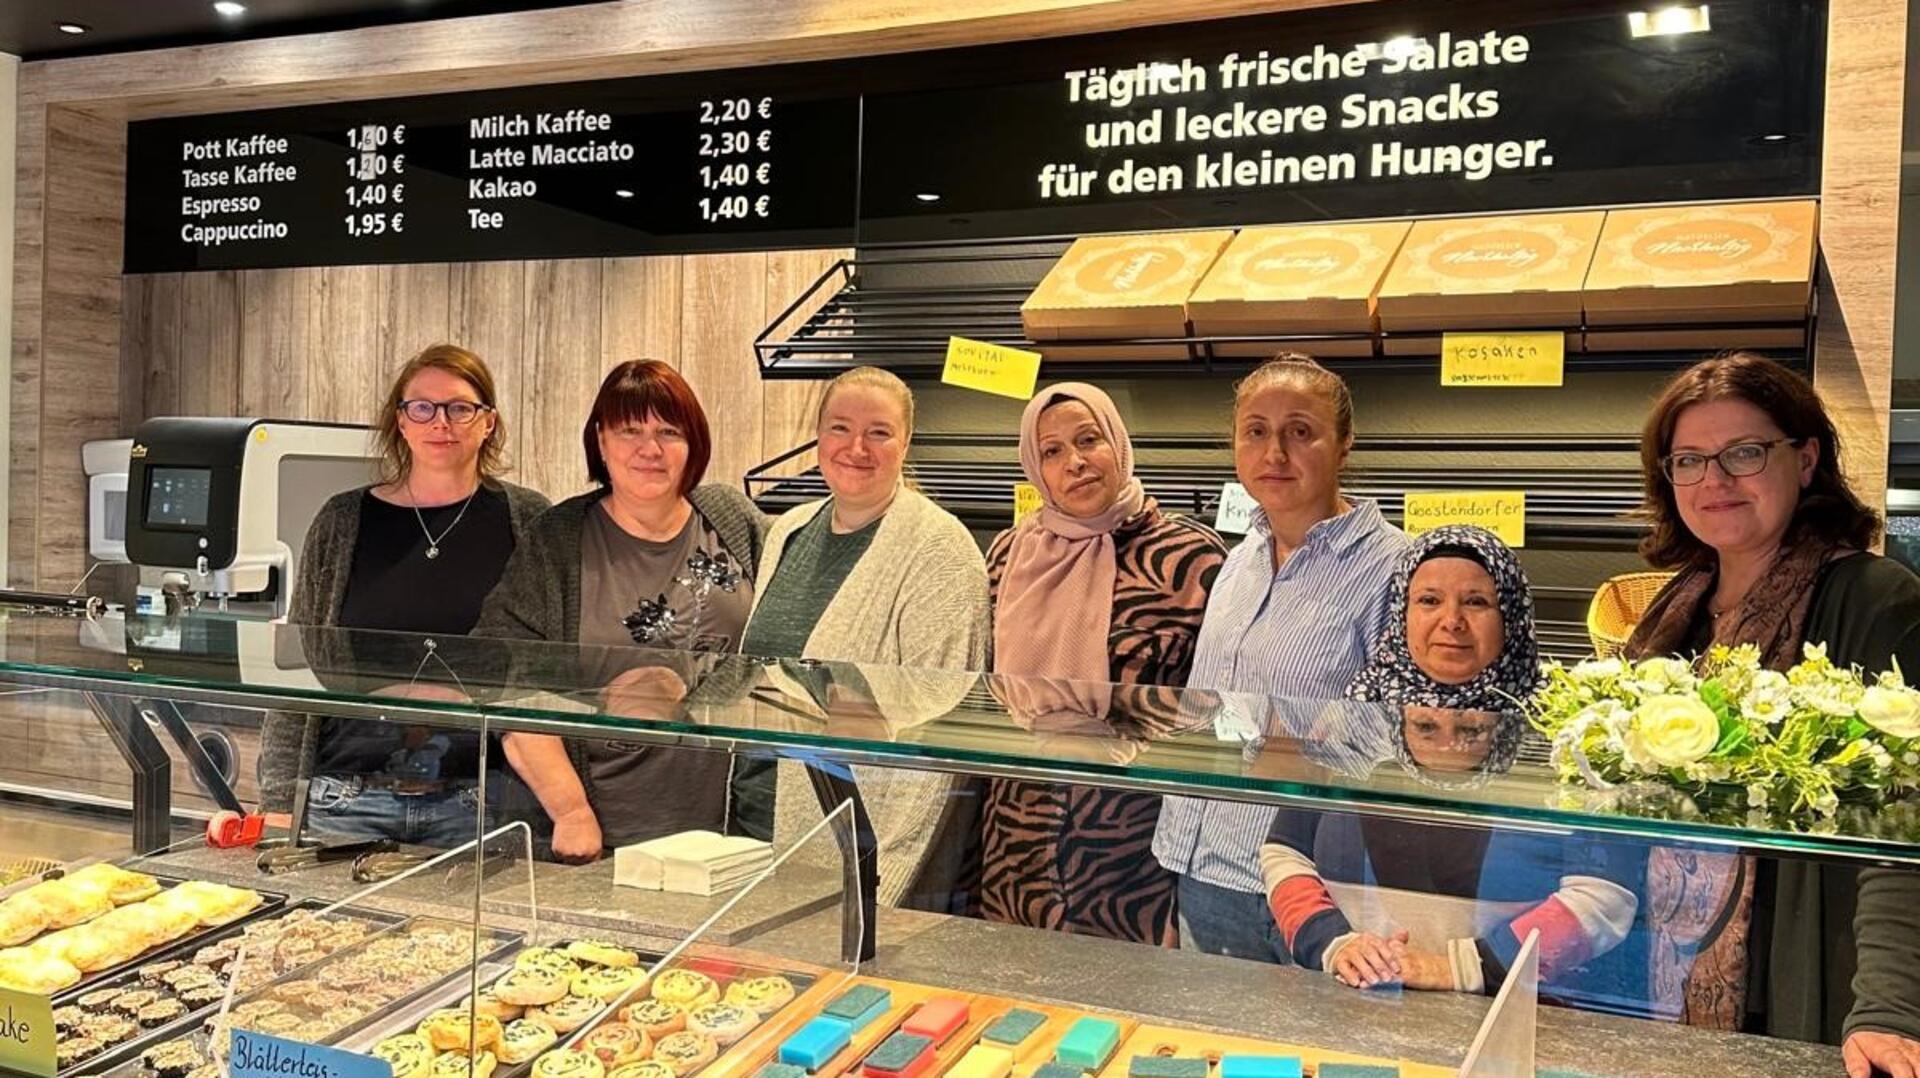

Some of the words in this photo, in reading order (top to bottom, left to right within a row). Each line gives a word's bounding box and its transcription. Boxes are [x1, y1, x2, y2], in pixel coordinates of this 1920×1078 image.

[1065, 57, 1206, 108] Täglich
[1219, 43, 1367, 88] frische
[1381, 31, 1530, 75] Salate
[470, 115, 529, 139] Milch
[536, 110, 612, 134] Kaffee
[700, 99, 751, 125] 2,20
[758, 97, 772, 119] €
[1086, 108, 1162, 148] und
[1176, 102, 1327, 141] leckere
[1341, 83, 1499, 128] Snacks
[183, 141, 222, 161] Pott
[226, 135, 288, 158] Kaffee
[393, 124, 406, 145] €
[469, 148, 526, 169] Latte
[532, 140, 634, 166] Macciato
[699, 131, 750, 157] 2,30
[757, 130, 771, 152] €
[182, 169, 229, 188] Tasse
[234, 162, 297, 185] Kaffee
[392, 154, 405, 174] €
[469, 176, 536, 199] Kakao
[699, 164, 750, 190] 1,40
[756, 163, 770, 185] €
[1038, 164, 1097, 198] für
[1108, 161, 1182, 194] den
[1196, 150, 1355, 188] kleinen
[1371, 138, 1553, 180] Hunger.
[182, 195, 261, 219] Espresso
[345, 184, 387, 208] 1,40
[392, 183, 404, 204] €
[468, 209, 504, 229] Tee
[698, 196, 749, 222] 1,40
[754, 195, 769, 217] €
[181, 220, 288, 246] Cappuccino
[345, 213, 386, 237] 1,95
[391, 212, 404, 233] €
